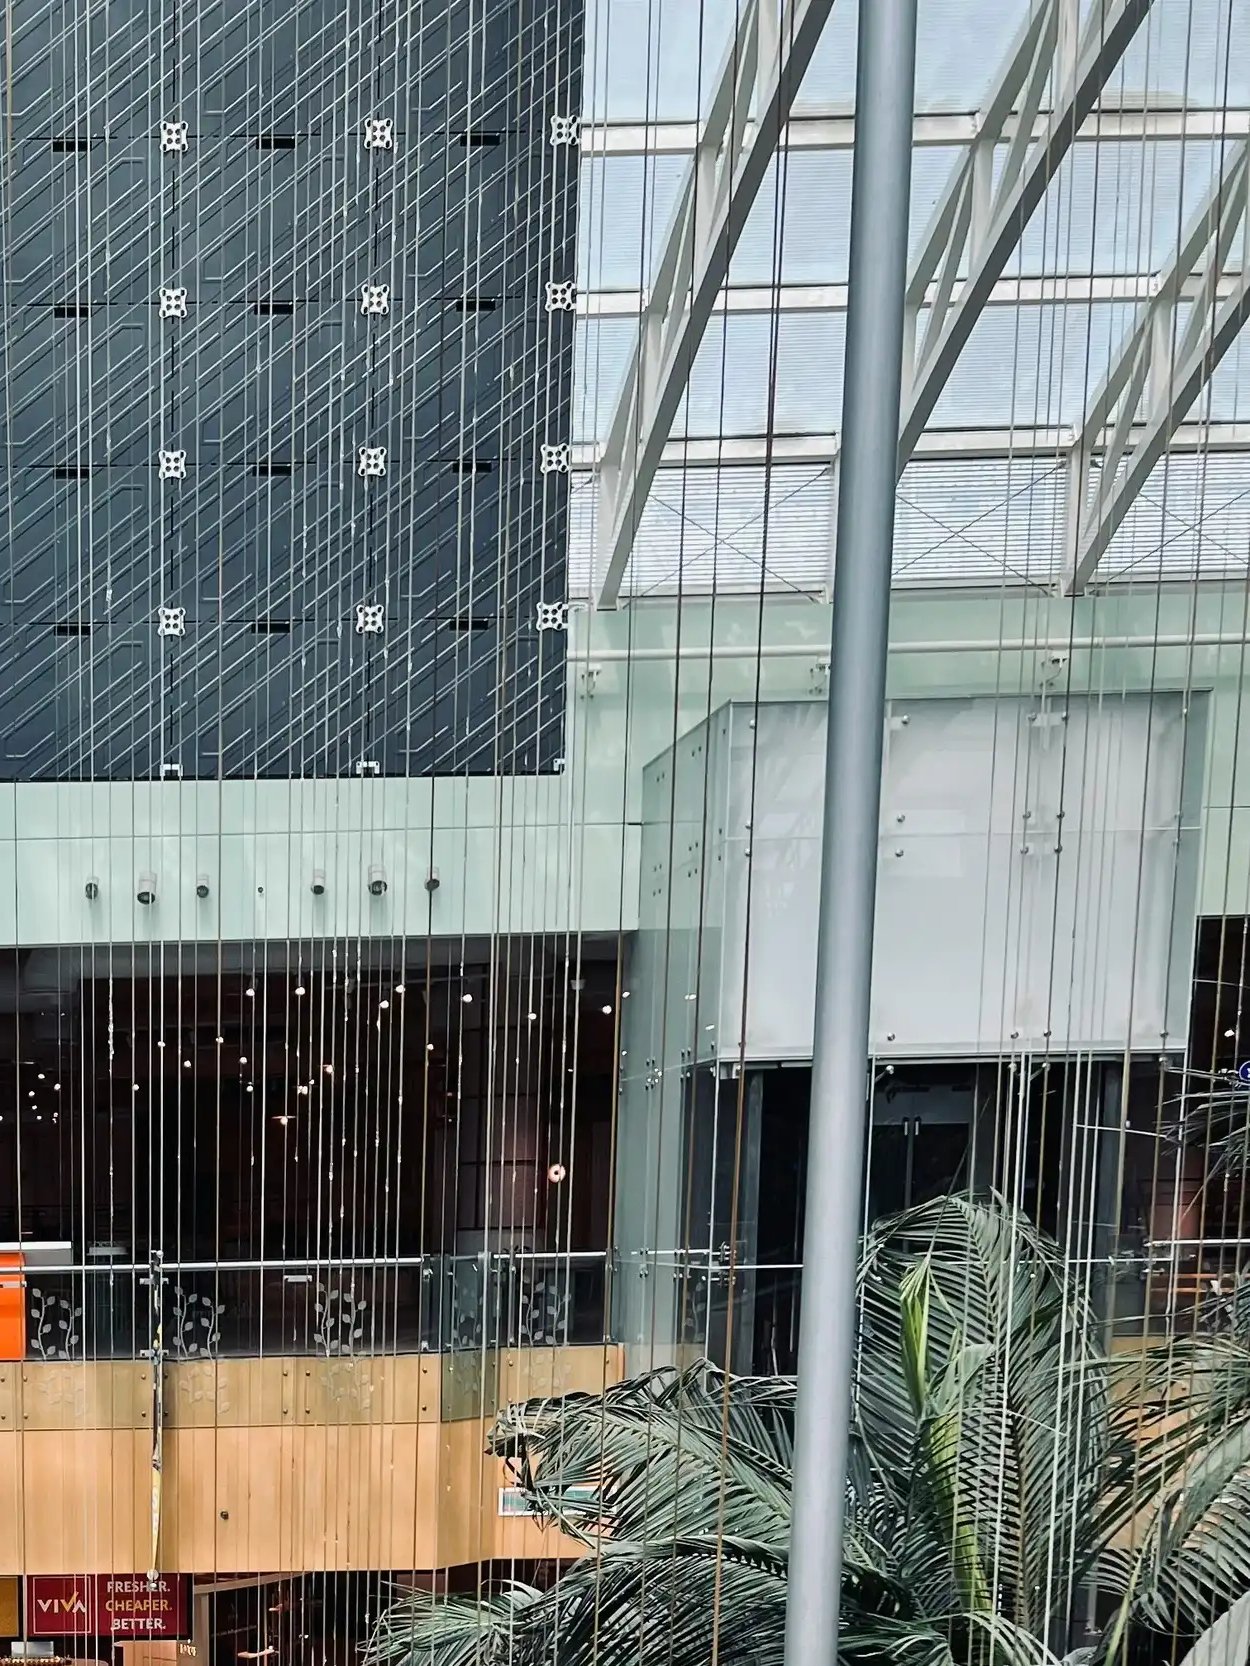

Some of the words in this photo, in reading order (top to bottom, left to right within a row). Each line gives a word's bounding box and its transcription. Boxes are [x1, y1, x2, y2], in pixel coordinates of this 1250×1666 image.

[37, 1591, 87, 1614] VIVA
[105, 1599, 173, 1612] CHEAPER.
[111, 1618, 167, 1631] BETTER.
